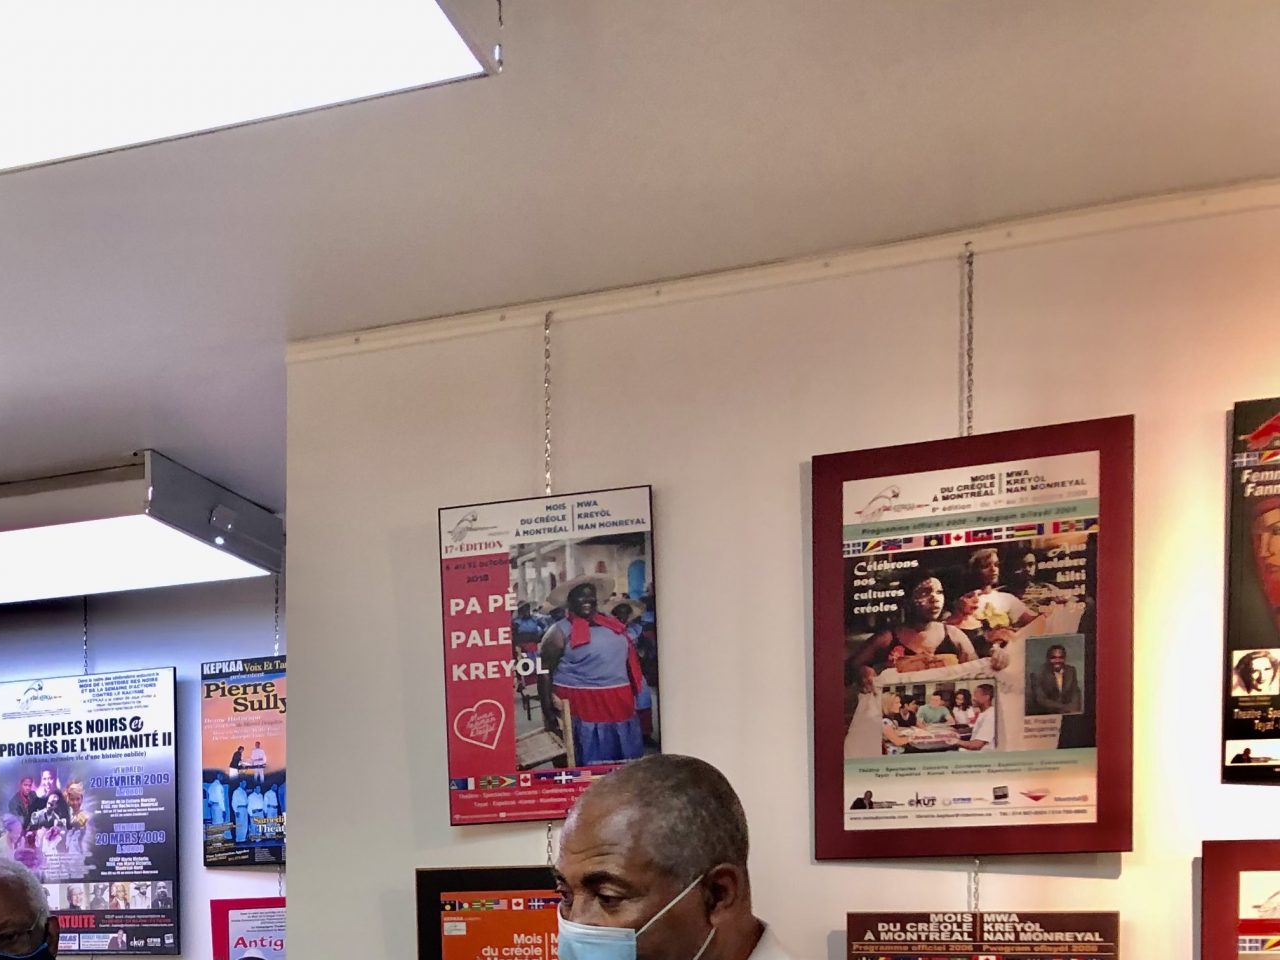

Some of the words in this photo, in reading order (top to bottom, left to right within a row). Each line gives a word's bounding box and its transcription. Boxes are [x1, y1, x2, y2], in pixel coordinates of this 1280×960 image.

[971, 474, 995, 482] MOIS
[1006, 470, 1029, 478] MWA
[957, 480, 995, 492] CRÉOLE
[1006, 475, 1046, 486] KREYÒL
[1006, 485, 1027, 493] NAN
[1031, 479, 1086, 490] MONREYAL
[942, 489, 995, 501] MONTRÉAL
[546, 504, 566, 512] MOIS
[534, 514, 566, 524] CRÉOLE
[578, 510, 611, 519] KREYÒL
[578, 522, 596, 530] NAN
[598, 518, 646, 530] MONREYAL
[515, 529, 520, 537] À
[523, 525, 568, 536] MONTRÉAL
[854, 560, 919, 576] Célébrons
[854, 589, 905, 600] cultures
[450, 596, 482, 616] PA
[488, 587, 518, 613] PÈ
[854, 602, 898, 614] créoles
[451, 626, 512, 648] PALE
[203, 660, 244, 674] KEPKAA
[244, 663, 262, 672] Voix
[264, 661, 272, 670] Et
[452, 652, 550, 682] KREYÒL
[204, 680, 275, 698] Pierre
[233, 694, 286, 714] Sully
[28, 720, 82, 738] PEUPLES
[86, 717, 128, 734] NOIRS
[0, 738, 58, 758] PROGRÈS
[62, 739, 77, 752] DE
[80, 730, 158, 752] L'HUMANITÉ
[162, 732, 172, 746] II
[90, 778, 102, 788] 20
[144, 774, 170, 784] 2009
[96, 833, 108, 846] 20
[110, 832, 138, 844] MARS
[139, 830, 166, 844] 2009
[930, 914, 972, 922] MOIS
[984, 914, 1020, 922] MWA
[878, 922, 902, 932] DU
[906, 921, 972, 932] CRÉOLE
[984, 921, 1044, 932] KREYÒL
[513, 934, 542, 944] Mois
[864, 930, 876, 940] À
[881, 930, 972, 941] MONTRÉAL
[984, 932, 1016, 941] NAN
[1020, 932, 1104, 942] MONREYAL
[234, 936, 284, 952] Antig
[482, 946, 498, 956] du
[502, 944, 542, 956] créole
[852, 944, 910, 952] Programme
[912, 944, 946, 952] officiel
[949, 944, 974, 952] 2006
